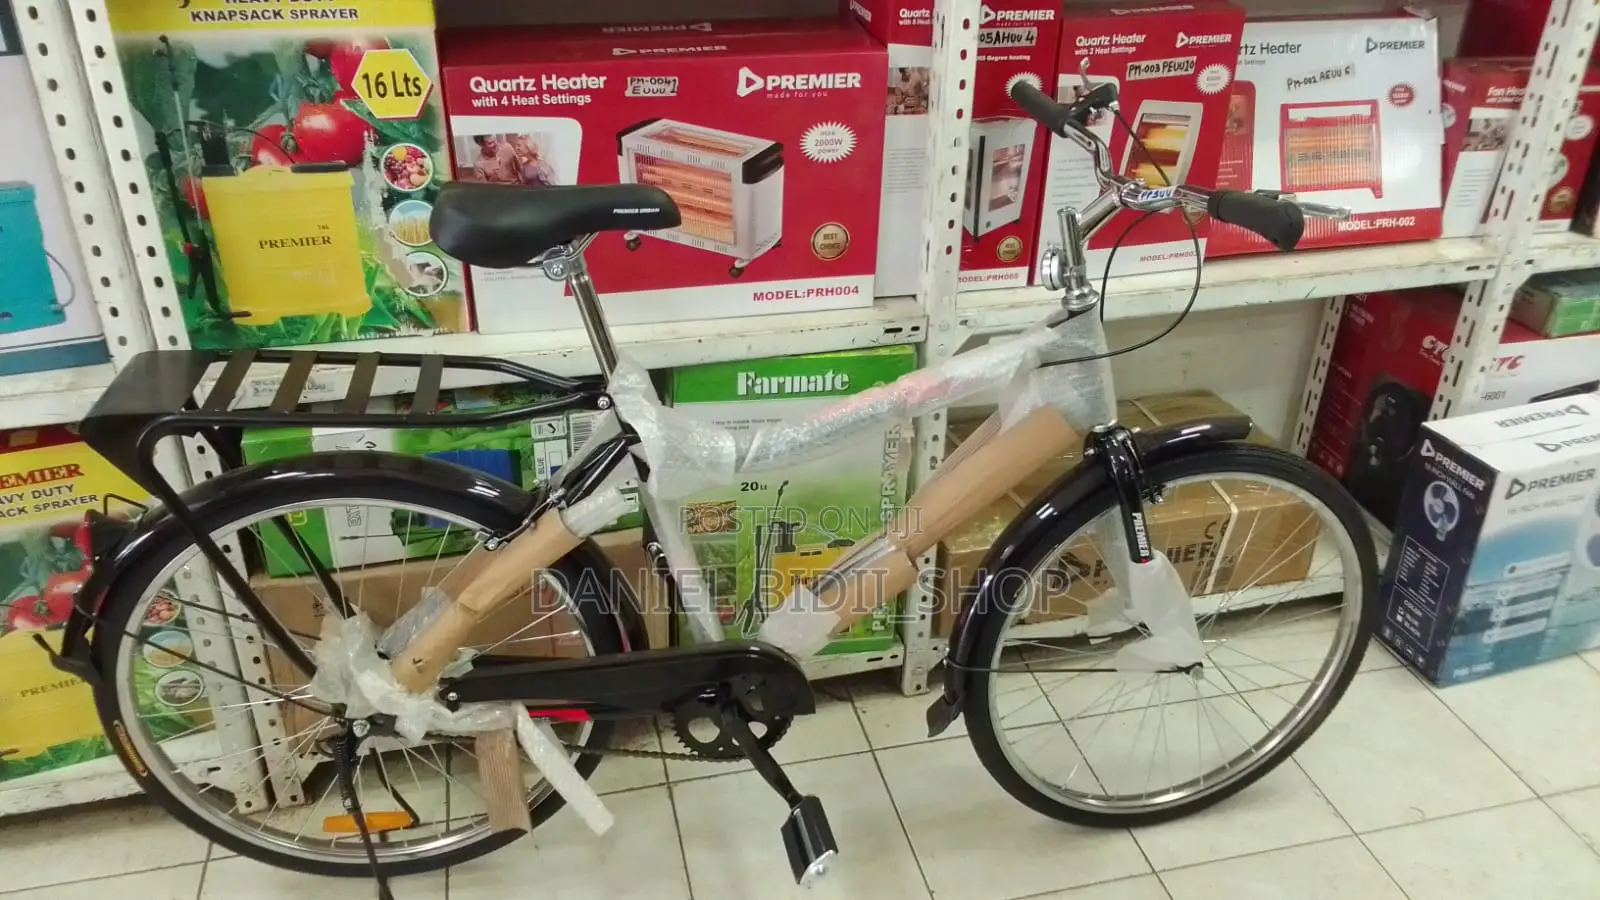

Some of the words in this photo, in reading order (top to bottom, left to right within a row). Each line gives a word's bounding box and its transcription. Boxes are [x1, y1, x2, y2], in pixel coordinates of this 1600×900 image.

[191, 9, 284, 22] KNAPSACK
[290, 8, 359, 20] SPRAYER
[900, 8, 931, 18] Quartz
[997, 9, 1055, 21] PREMIER
[1075, 34, 1111, 47] Quartz
[1112, 33, 1146, 44] Heater
[1188, 34, 1232, 45] PREMIER
[1379, 40, 1425, 50] PREMIER
[1239, 43, 1256, 55] rtz
[1260, 42, 1302, 55] Heater
[362, 72, 388, 99] 16
[391, 70, 422, 98] Lts
[469, 76, 537, 93] Quartz
[541, 74, 607, 90] Heater
[766, 72, 862, 91] PREMIER
[471, 96, 498, 107] with
[500, 96, 508, 106] 4
[511, 95, 540, 105] Heat
[542, 94, 591, 105] Settings
[258, 235, 332, 250] PREMIER
[823, 233, 838, 241] BEST
[753, 285, 859, 302] MODEL:PRH004
[737, 369, 850, 396] Farmate
[1494, 408, 1566, 428] PREMIER
[0, 464, 84, 490] EMIER
[1435, 452, 1485, 491] PREMIER
[741, 482, 759, 491] 20
[1527, 468, 1596, 493] PREMIER
[31, 484, 74, 499] DUTY
[33, 494, 98, 513] SPRAYER
[1132, 512, 1150, 557] PREMIER
